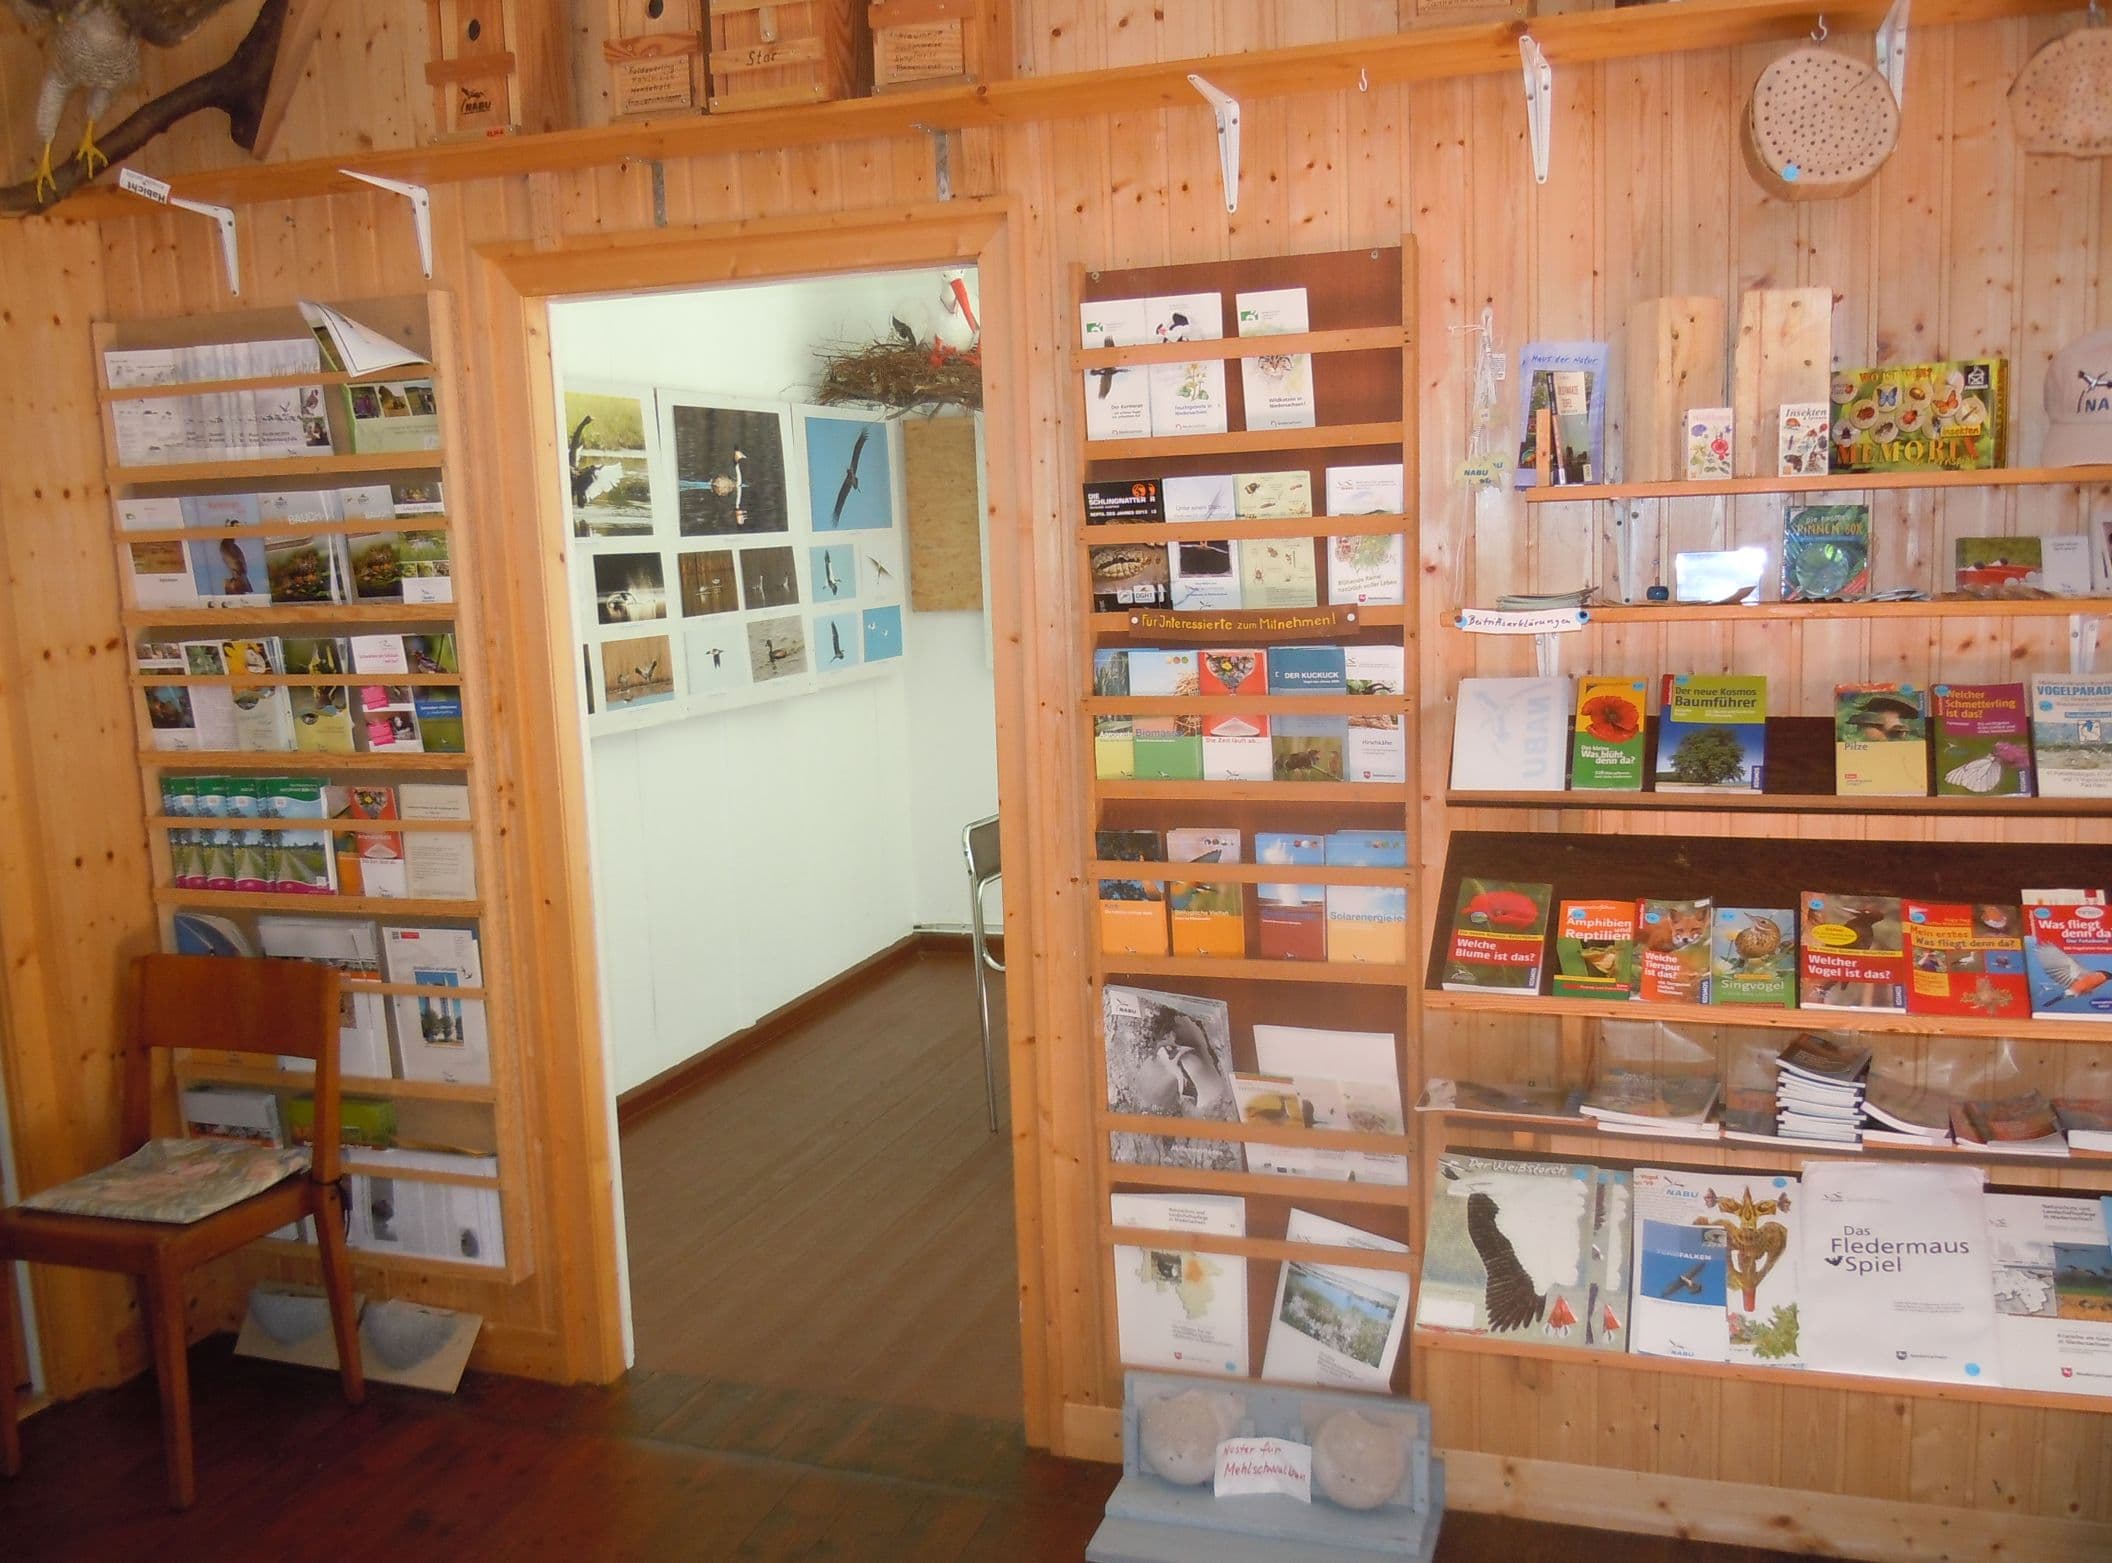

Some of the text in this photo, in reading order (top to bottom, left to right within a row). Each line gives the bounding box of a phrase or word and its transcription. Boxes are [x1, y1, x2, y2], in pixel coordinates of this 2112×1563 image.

[746, 50, 778, 67] Star
[465, 101, 492, 112] NABU
[127, 180, 166, 202] Habicht
[1785, 407, 1827, 417] Insekten
[1236, 621, 1257, 630] zum
[1284, 671, 1339, 679] DER KUCKUCK
[1675, 686, 1757, 696] Der neue Kosmos
[1675, 696, 1757, 709] Baumführer
[1945, 698, 2016, 710] Schmetterling
[1946, 708, 1983, 719] ist das?
[1844, 742, 1868, 752] Pilze
[1581, 750, 1624, 759] Was blüht
[1595, 756, 1636, 765] denn da?
[1567, 916, 1632, 928] Amphibien
[2039, 919, 2101, 932] Was fliegt
[1565, 928, 1631, 942] Reptilien
[1911, 925, 1969, 938] Mein erstes
[2061, 928, 2112, 938] denn da
[1457, 938, 1497, 950] Welche
[1915, 937, 2016, 949] Was fliegt denn da?
[1455, 948, 1536, 962] Blume ist das?
[1645, 952, 1677, 963] Welche
[1808, 954, 1857, 967] Welcher
[1645, 961, 1681, 971] Tierspur
[1807, 964, 1891, 980] Vogel ist das?
[1644, 968, 1678, 979] ist das?
[1721, 980, 1785, 992] Singvögel
[1469, 1158, 1492, 1170] Der
[1666, 1188, 1699, 1198] NABU
[1844, 1225, 1871, 1236] Das
[1831, 1237, 1970, 1255] Fledermaus
[1845, 1255, 1902, 1276] Spiel
